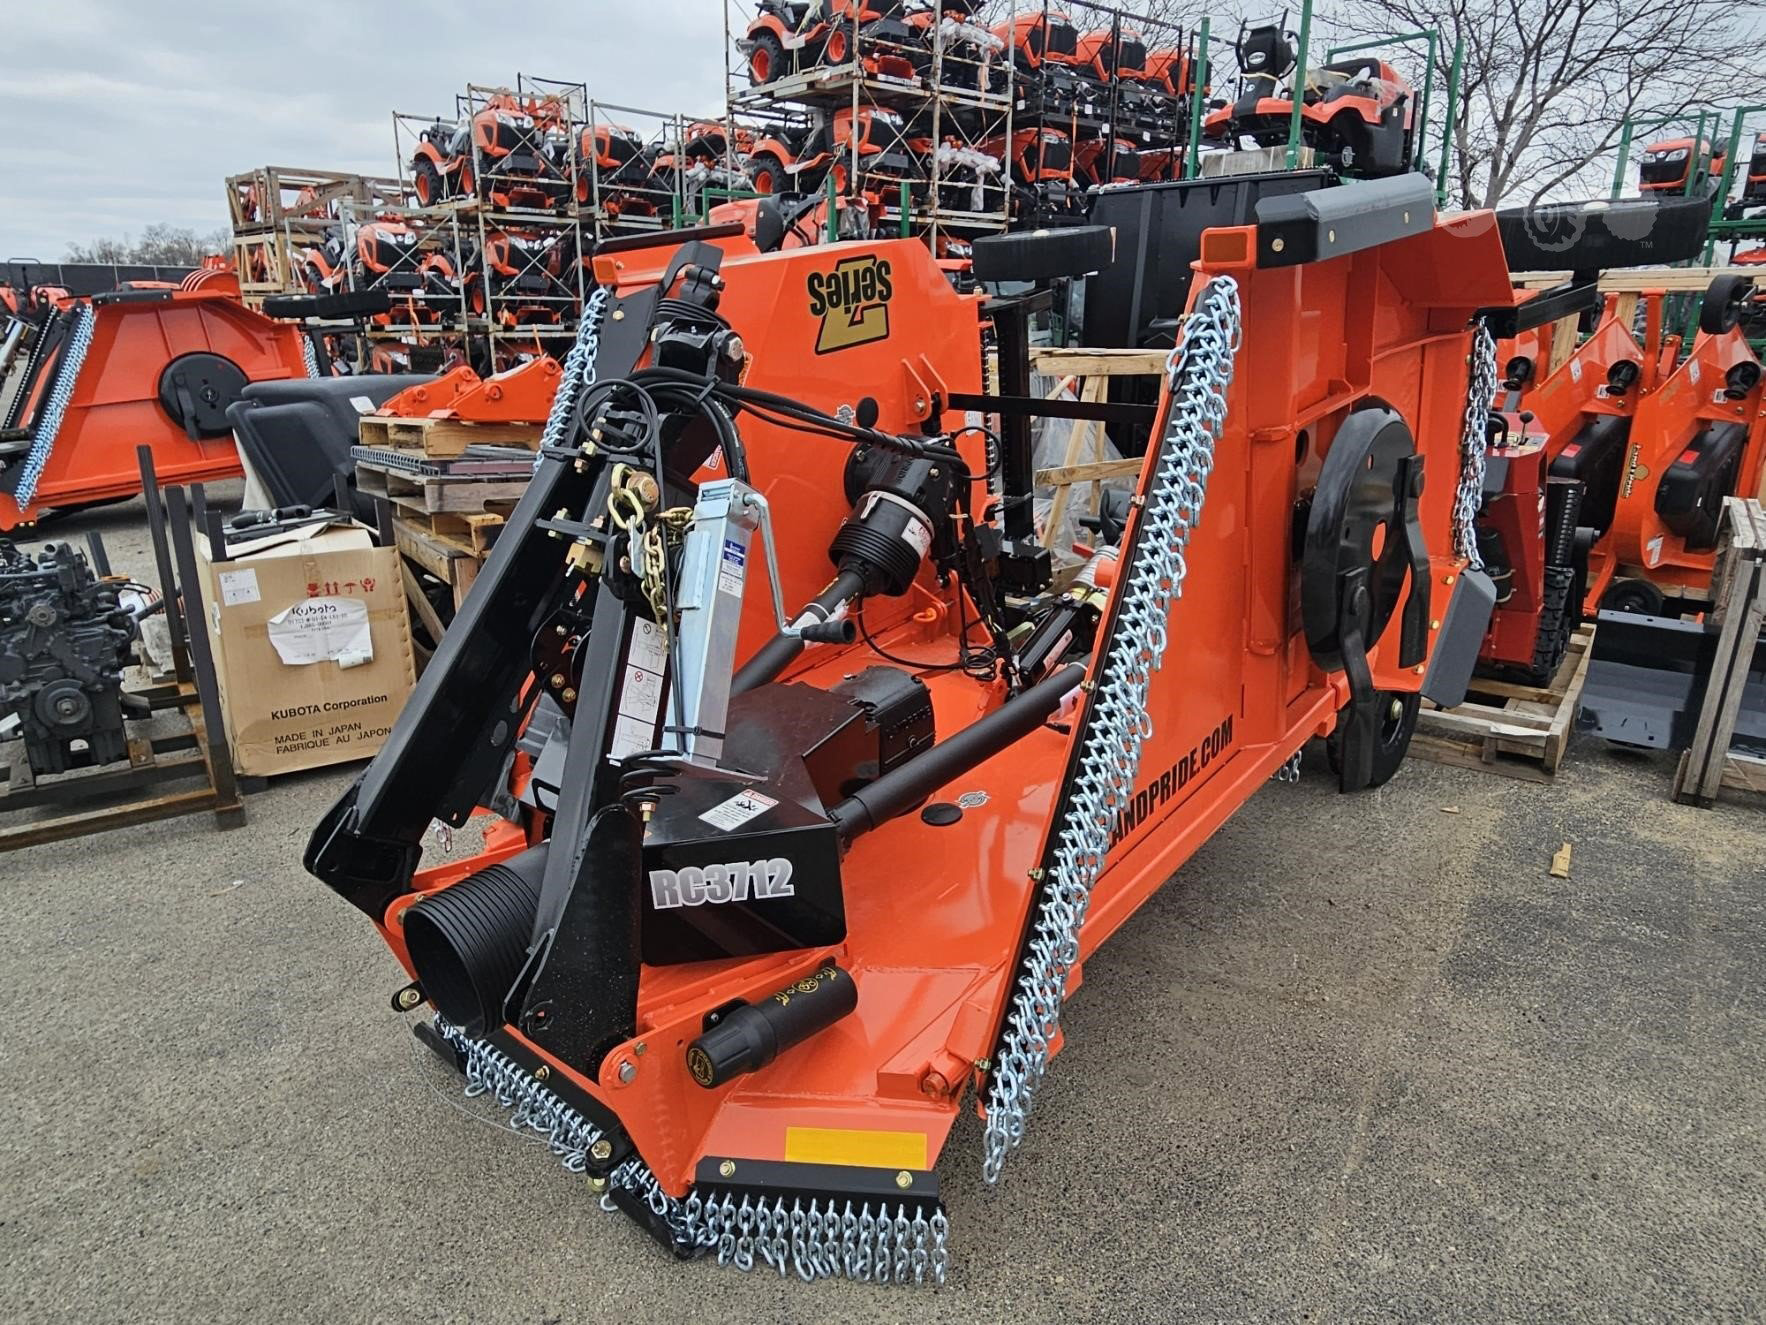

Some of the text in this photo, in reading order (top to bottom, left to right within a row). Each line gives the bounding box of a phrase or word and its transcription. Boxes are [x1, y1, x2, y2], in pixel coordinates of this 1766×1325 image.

[292, 604, 337, 617] Kubota
[271, 695, 388, 720] KUBOTA Corporation
[274, 722, 362, 744] MADE IN JAPAN
[276, 727, 392, 754] FABRIQUE AU JAPON
[1109, 715, 1233, 850] ANDPRIDE.COM
[649, 857, 795, 910] RC3712
